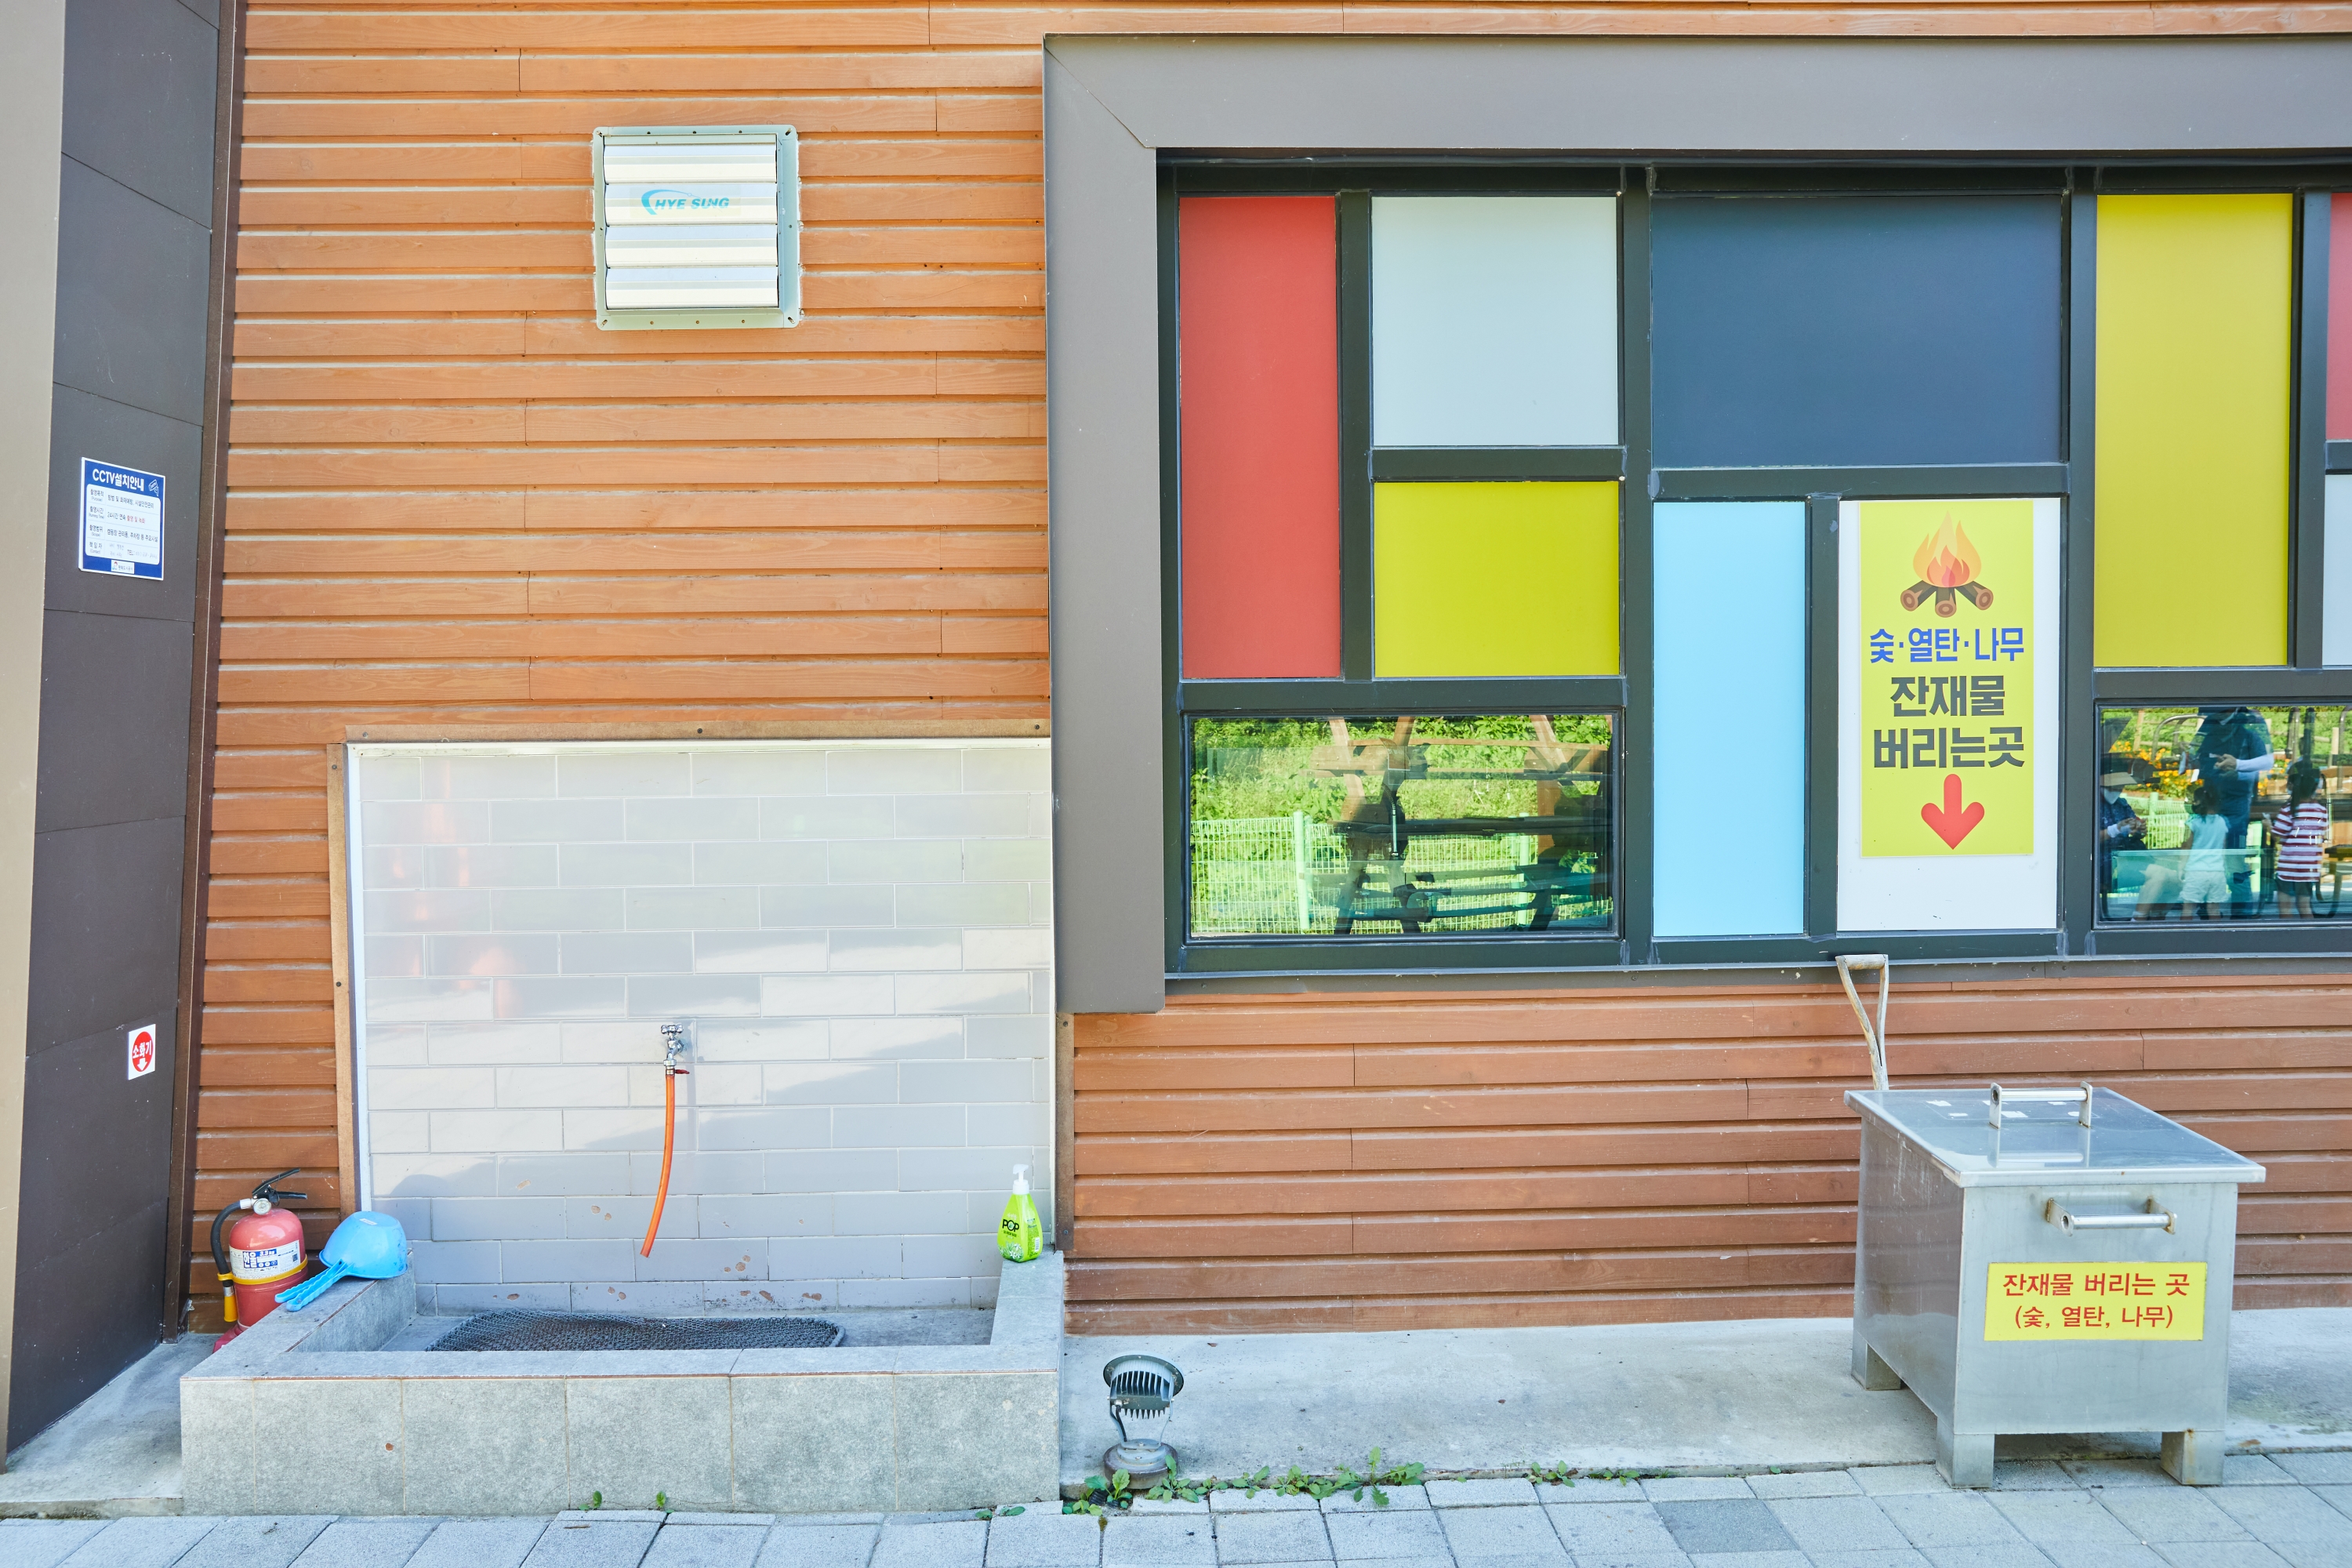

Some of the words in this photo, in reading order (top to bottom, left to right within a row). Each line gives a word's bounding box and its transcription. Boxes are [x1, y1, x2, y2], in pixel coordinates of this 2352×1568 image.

[655, 199, 687, 209] HYE
[691, 198, 729, 209] SUNG
[93, 469, 143, 491] CCTV설치안내
[1890, 675, 2005, 717] 잔재물
[1874, 726, 2025, 769] 버리는곳
[132, 1040, 151, 1058] 소화기
[1002, 1219, 1019, 1232] POP
[2002, 1273, 2074, 1296] 잔재물
[2085, 1272, 2156, 1296] 버리는
[2165, 1273, 2190, 1296] 곳
[2015, 1305, 2050, 1329] (숯,
[2061, 1305, 2110, 1329] 열탄,
[2122, 1305, 2173, 1329] 나무)
